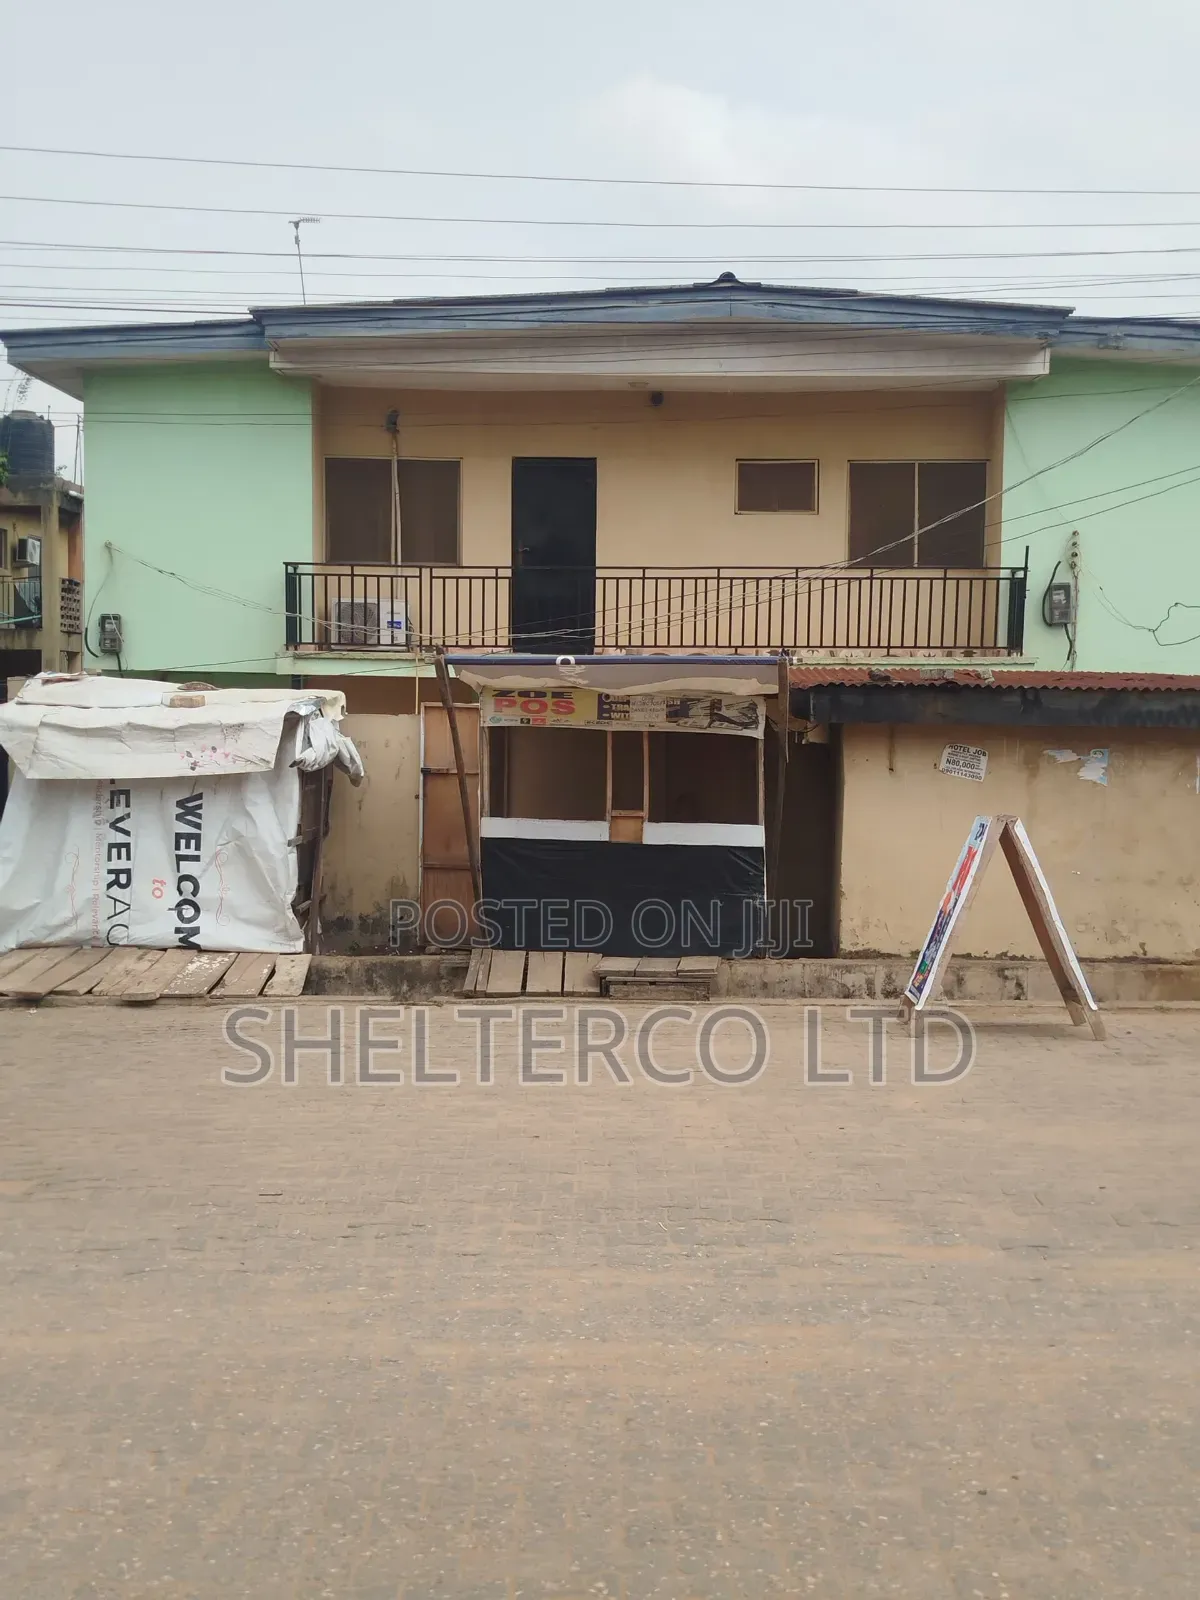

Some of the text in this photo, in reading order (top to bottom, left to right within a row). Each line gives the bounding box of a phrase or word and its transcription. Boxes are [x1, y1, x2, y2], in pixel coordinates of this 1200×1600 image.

[492, 689, 573, 699] ZOE
[494, 698, 576, 716] POS
[948, 745, 971, 753] HOTEL
[973, 749, 987, 757] JOB
[945, 758, 976, 770] N80,000
[151, 878, 167, 899] to
